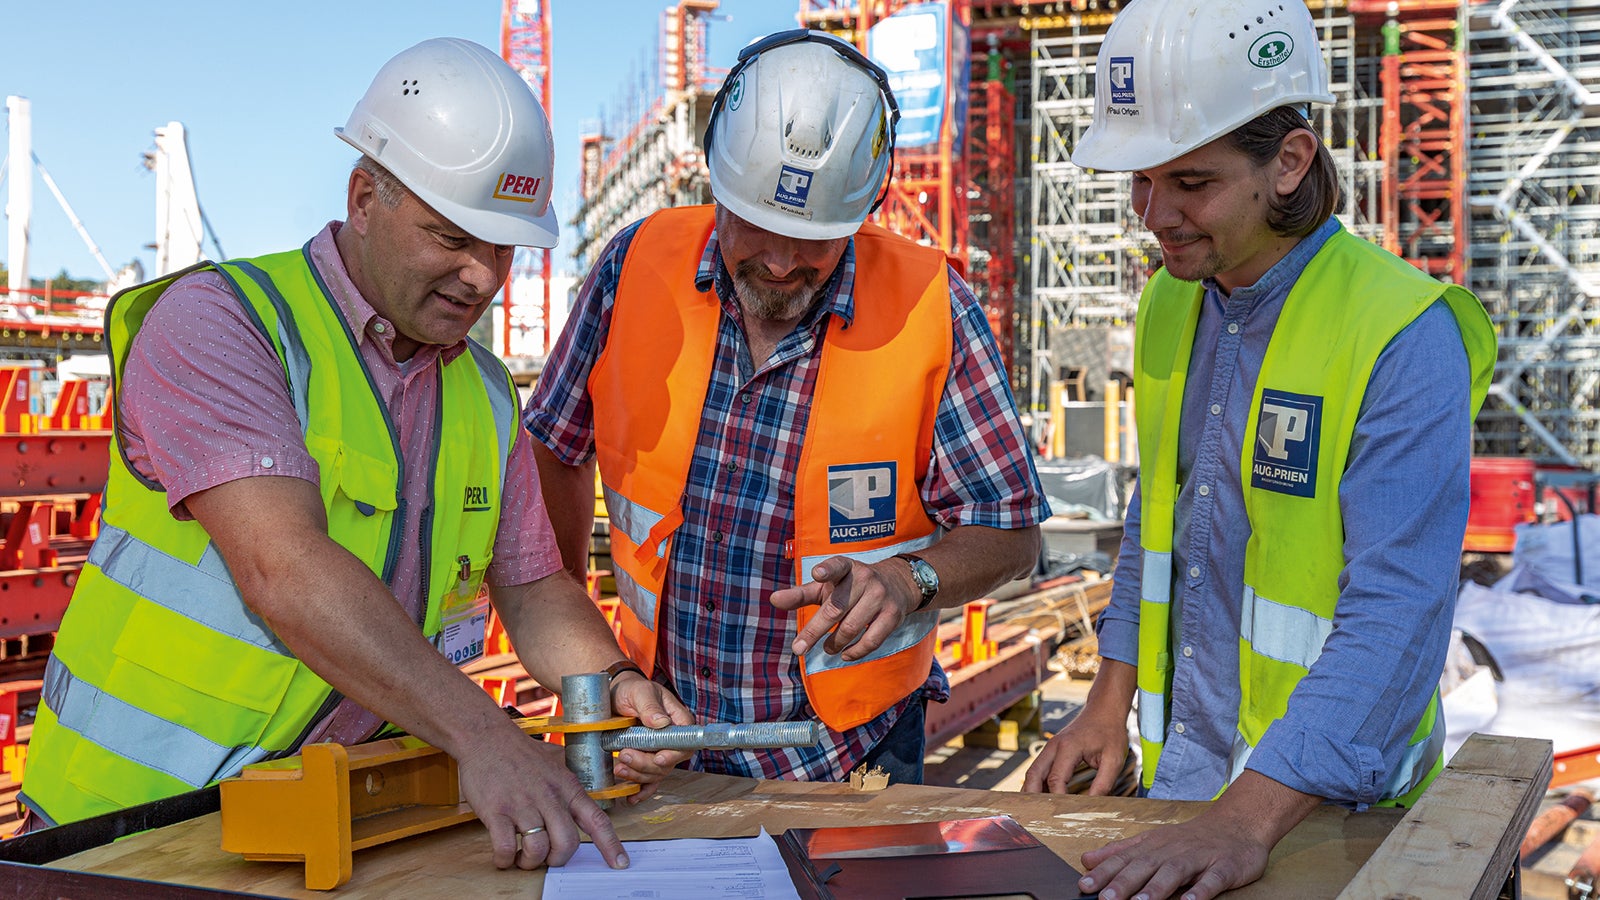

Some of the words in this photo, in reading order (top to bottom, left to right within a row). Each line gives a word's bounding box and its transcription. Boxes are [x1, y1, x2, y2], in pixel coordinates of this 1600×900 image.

[1257, 49, 1290, 66] Ersthelfer
[502, 174, 541, 196] PERI
[1253, 464, 1308, 484] AUG.PRIEN
[831, 522, 896, 538] AUG.PRIEN
